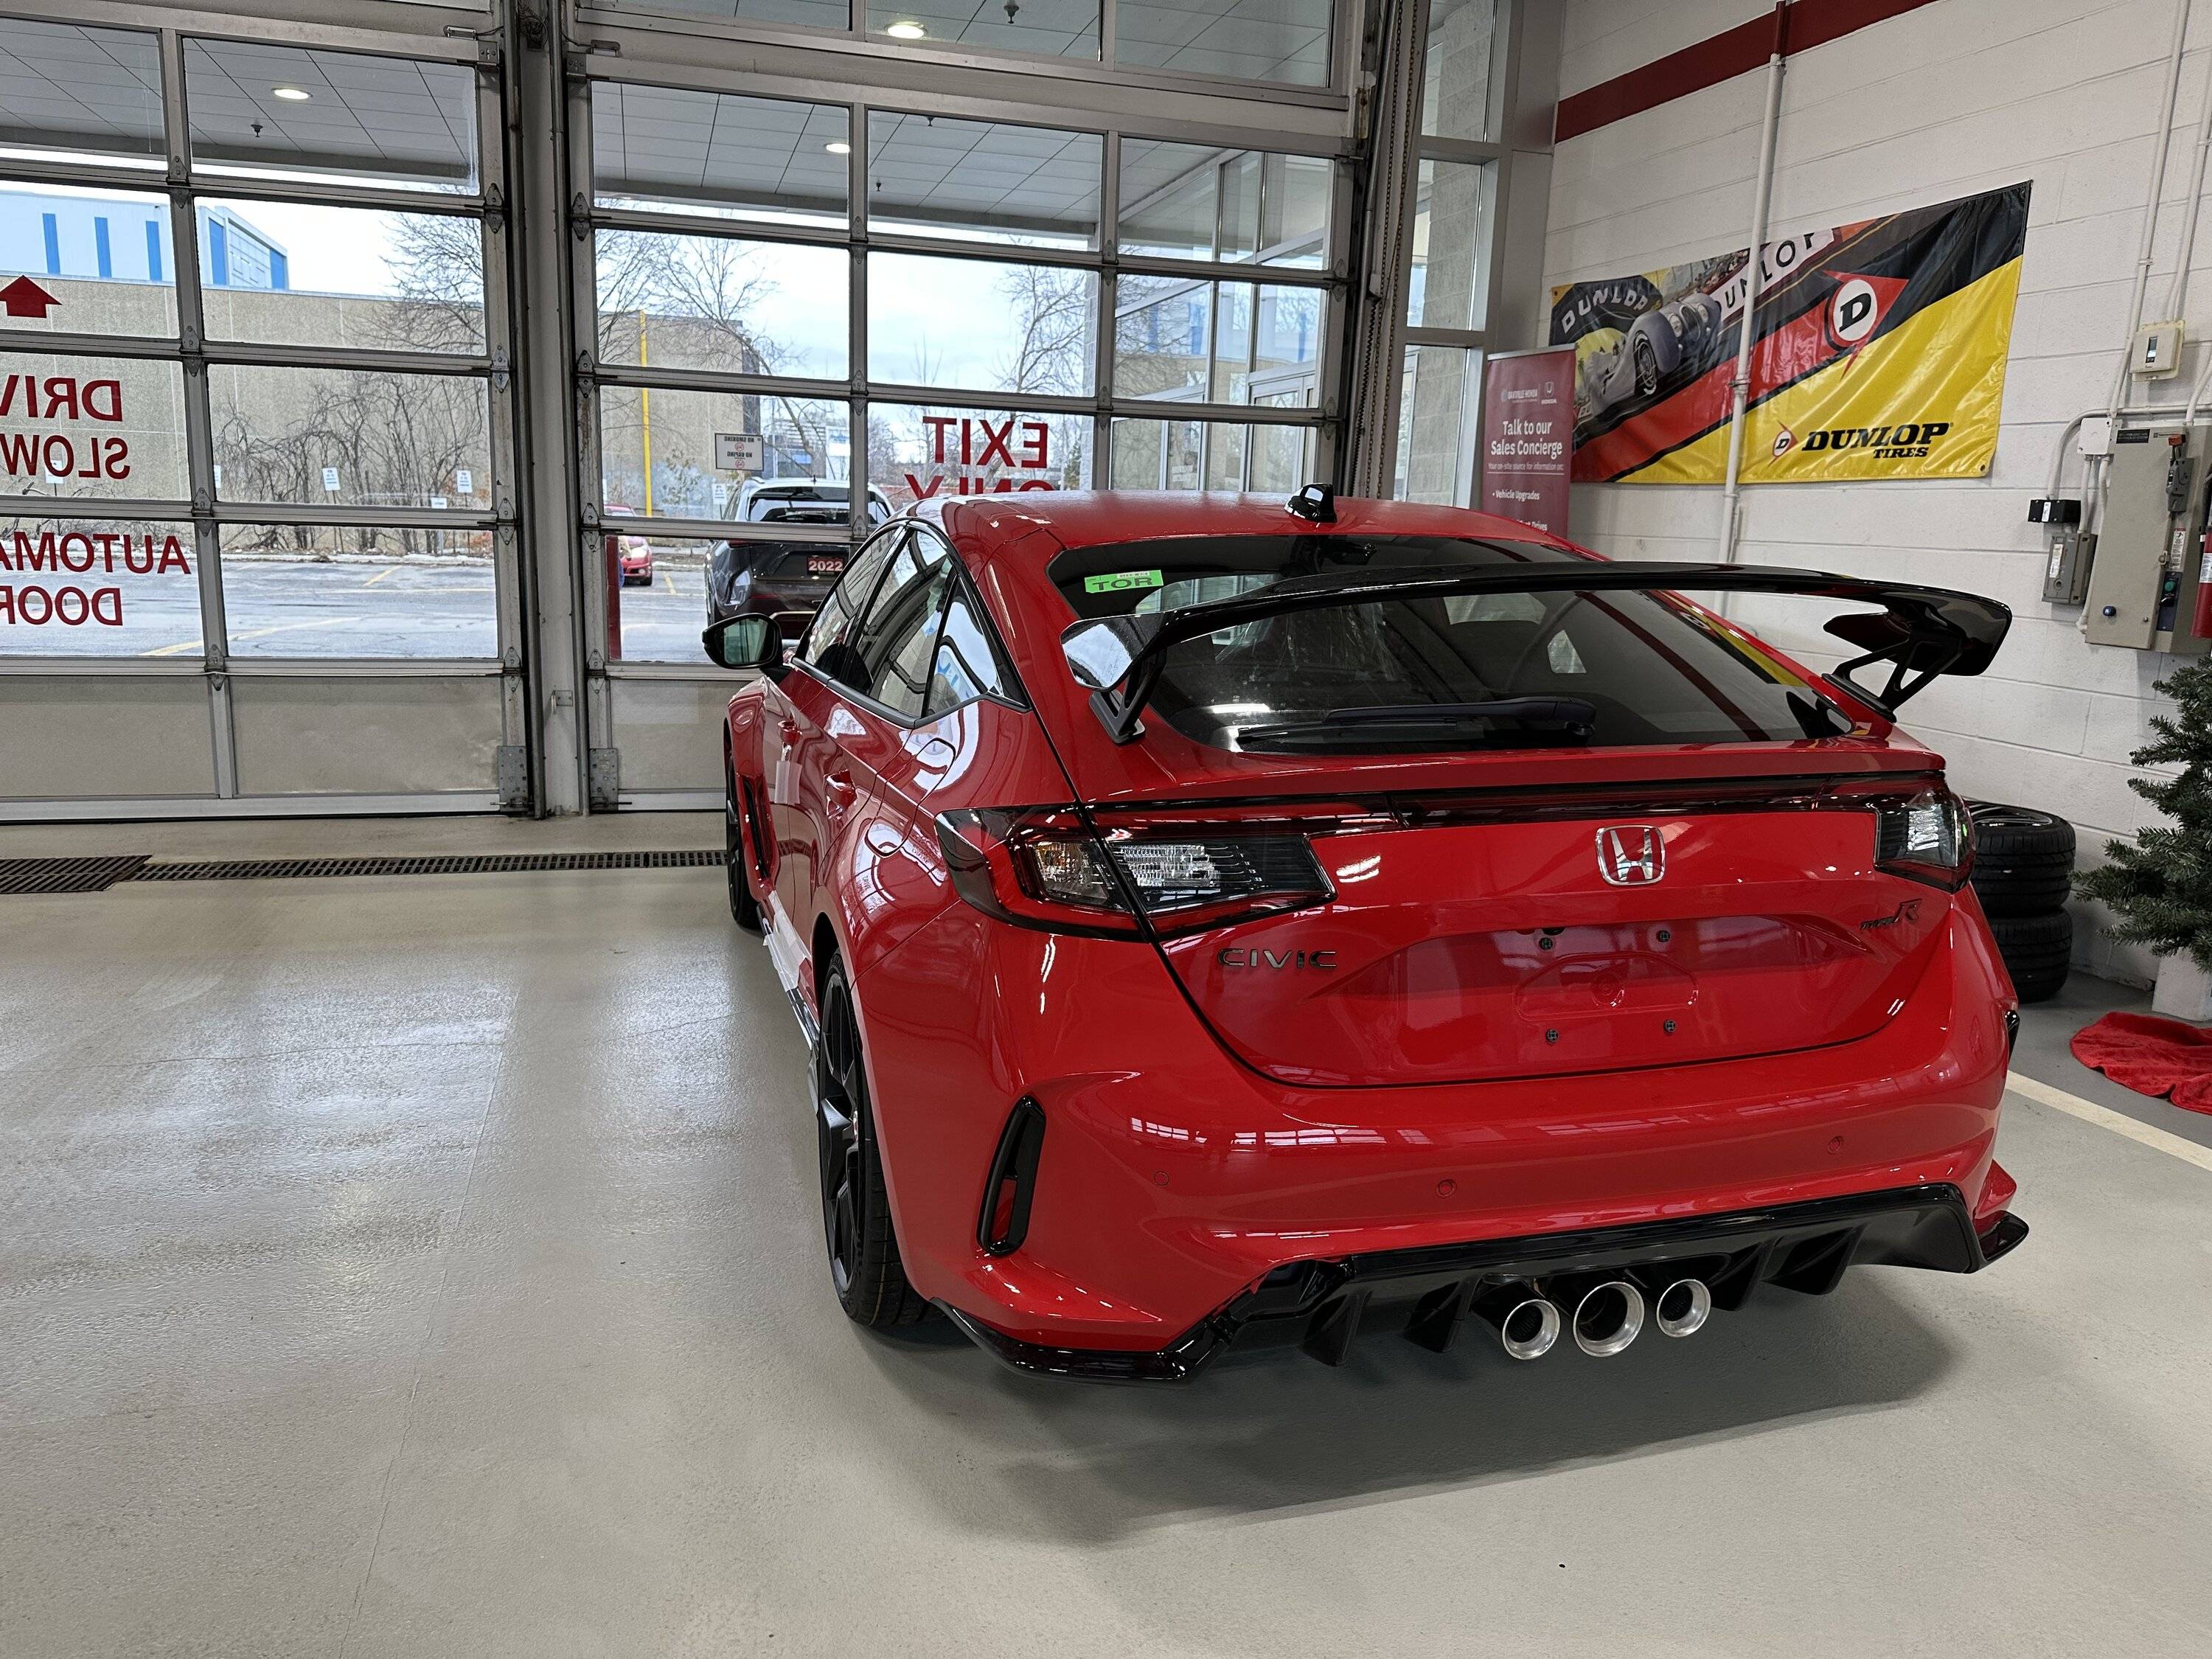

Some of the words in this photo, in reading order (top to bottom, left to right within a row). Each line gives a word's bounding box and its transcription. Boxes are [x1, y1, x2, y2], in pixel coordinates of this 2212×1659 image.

[1562, 286, 1648, 333] DUNLOP
[1839, 293, 1871, 333] D
[1503, 419, 1522, 435] Talk
[1524, 421, 1534, 434] to
[1536, 422, 1553, 434] our
[1775, 439, 1790, 449] D
[1802, 422, 1950, 451] DUNLOP
[1491, 439, 1515, 456] Sales
[1517, 438, 1563, 459] Concierge
[1874, 447, 1929, 459] TIRES
[1495, 490, 1515, 498] Vehicle
[1515, 490, 1540, 502] Upgrades
[808, 560, 844, 571] 2022
[1092, 577, 1152, 591] TOR
[1218, 947, 1337, 969] CIVIC
